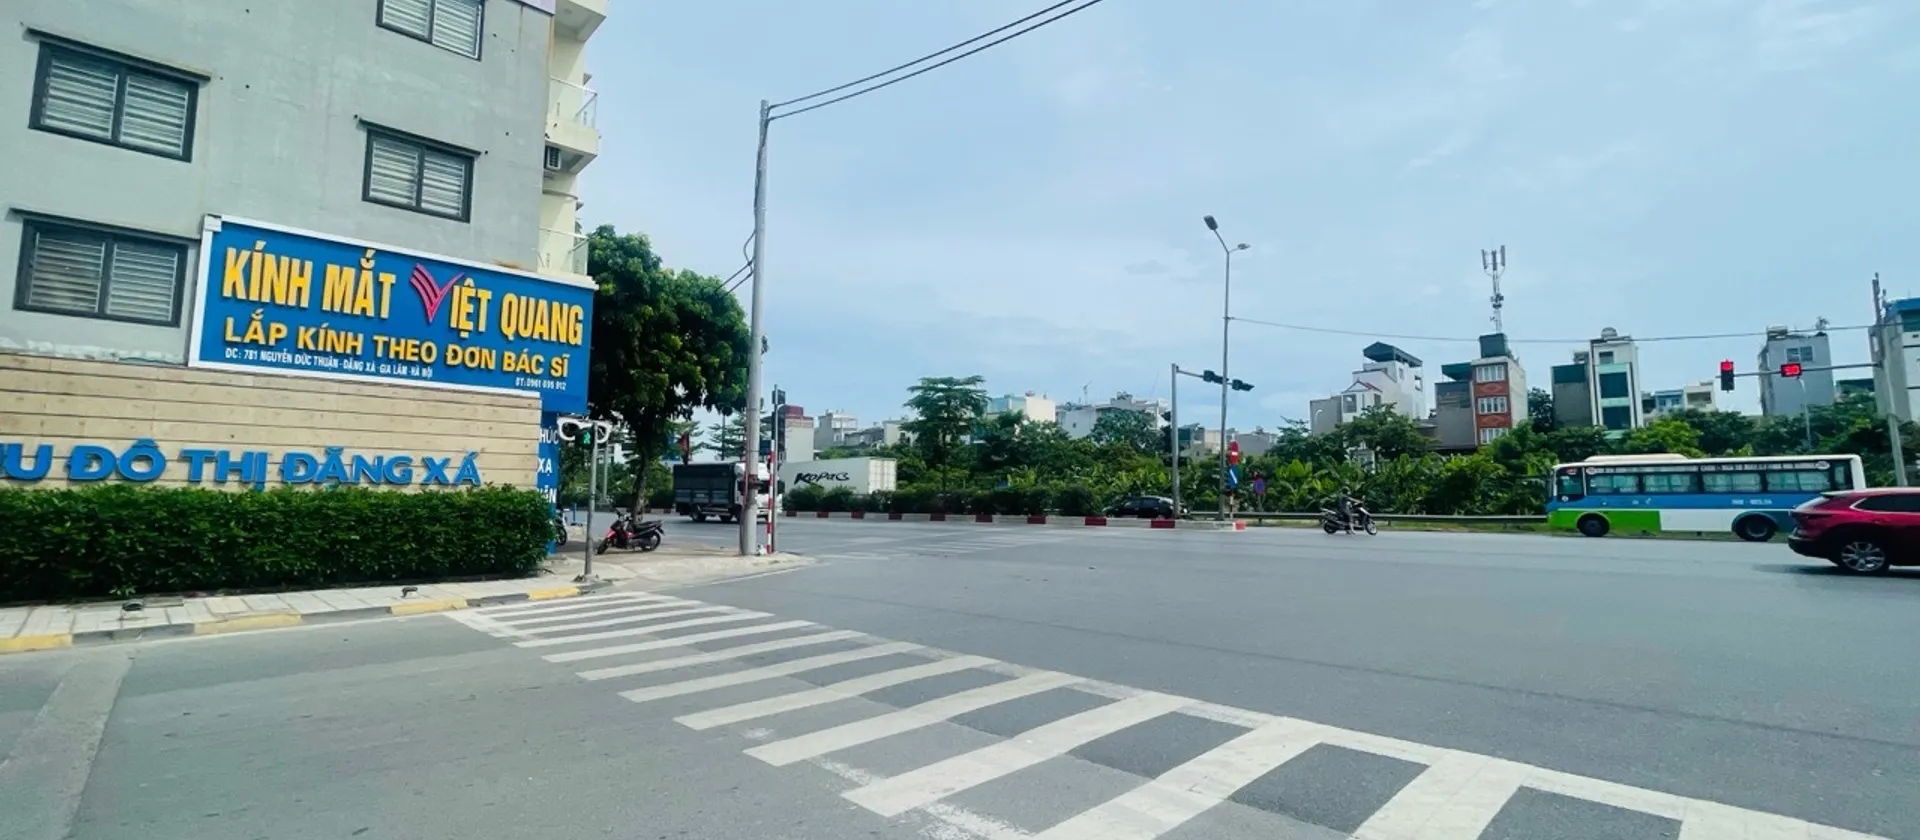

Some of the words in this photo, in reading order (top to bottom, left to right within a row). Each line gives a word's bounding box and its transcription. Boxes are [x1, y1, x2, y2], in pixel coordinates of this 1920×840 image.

[222, 240, 313, 308] KÍNH
[322, 249, 397, 319] MẮT
[501, 292, 584, 345] QUANG
[225, 308, 288, 346] LẮP
[297, 323, 363, 355] KÍNH
[373, 335, 437, 364] THEO
[446, 344, 496, 370] ĐƠN
[503, 347, 544, 375] BÁC
[551, 353, 570, 378] SĨ
[0, 442, 53, 482] U
[66, 438, 166, 482] ĐÔ
[179, 448, 268, 491] THỊ
[280, 446, 414, 489] ĐẶNG
[420, 451, 481, 486] XÁ
